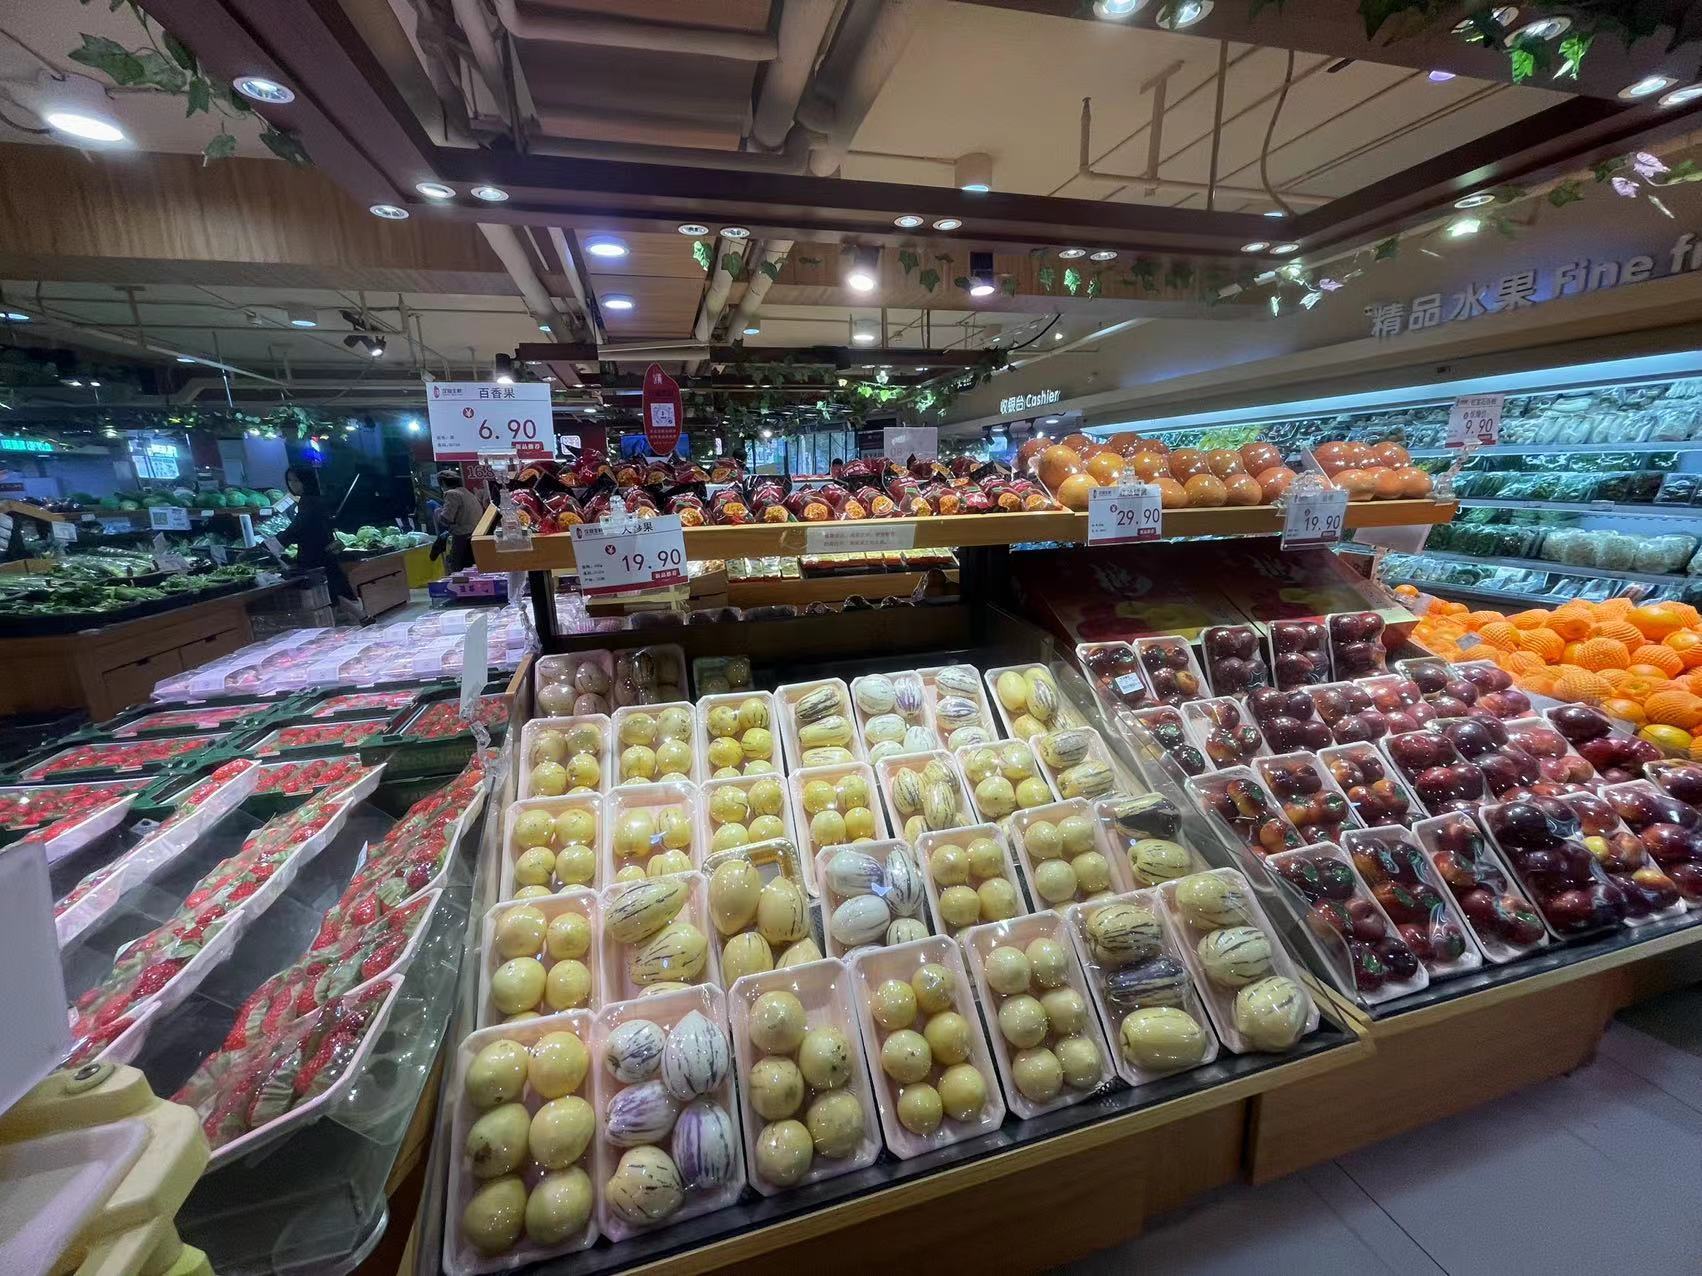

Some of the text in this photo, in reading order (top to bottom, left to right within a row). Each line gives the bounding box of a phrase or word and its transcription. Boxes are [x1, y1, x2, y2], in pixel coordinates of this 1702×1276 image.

[1555, 255, 1654, 297] Fine
[1371, 271, 1537, 337] 精品水果
[478, 386, 516, 399] 百香果
[1026, 389, 1060, 408] Cashier
[1000, 394, 1025, 414] 收银台
[622, 548, 681, 572] 19.90
